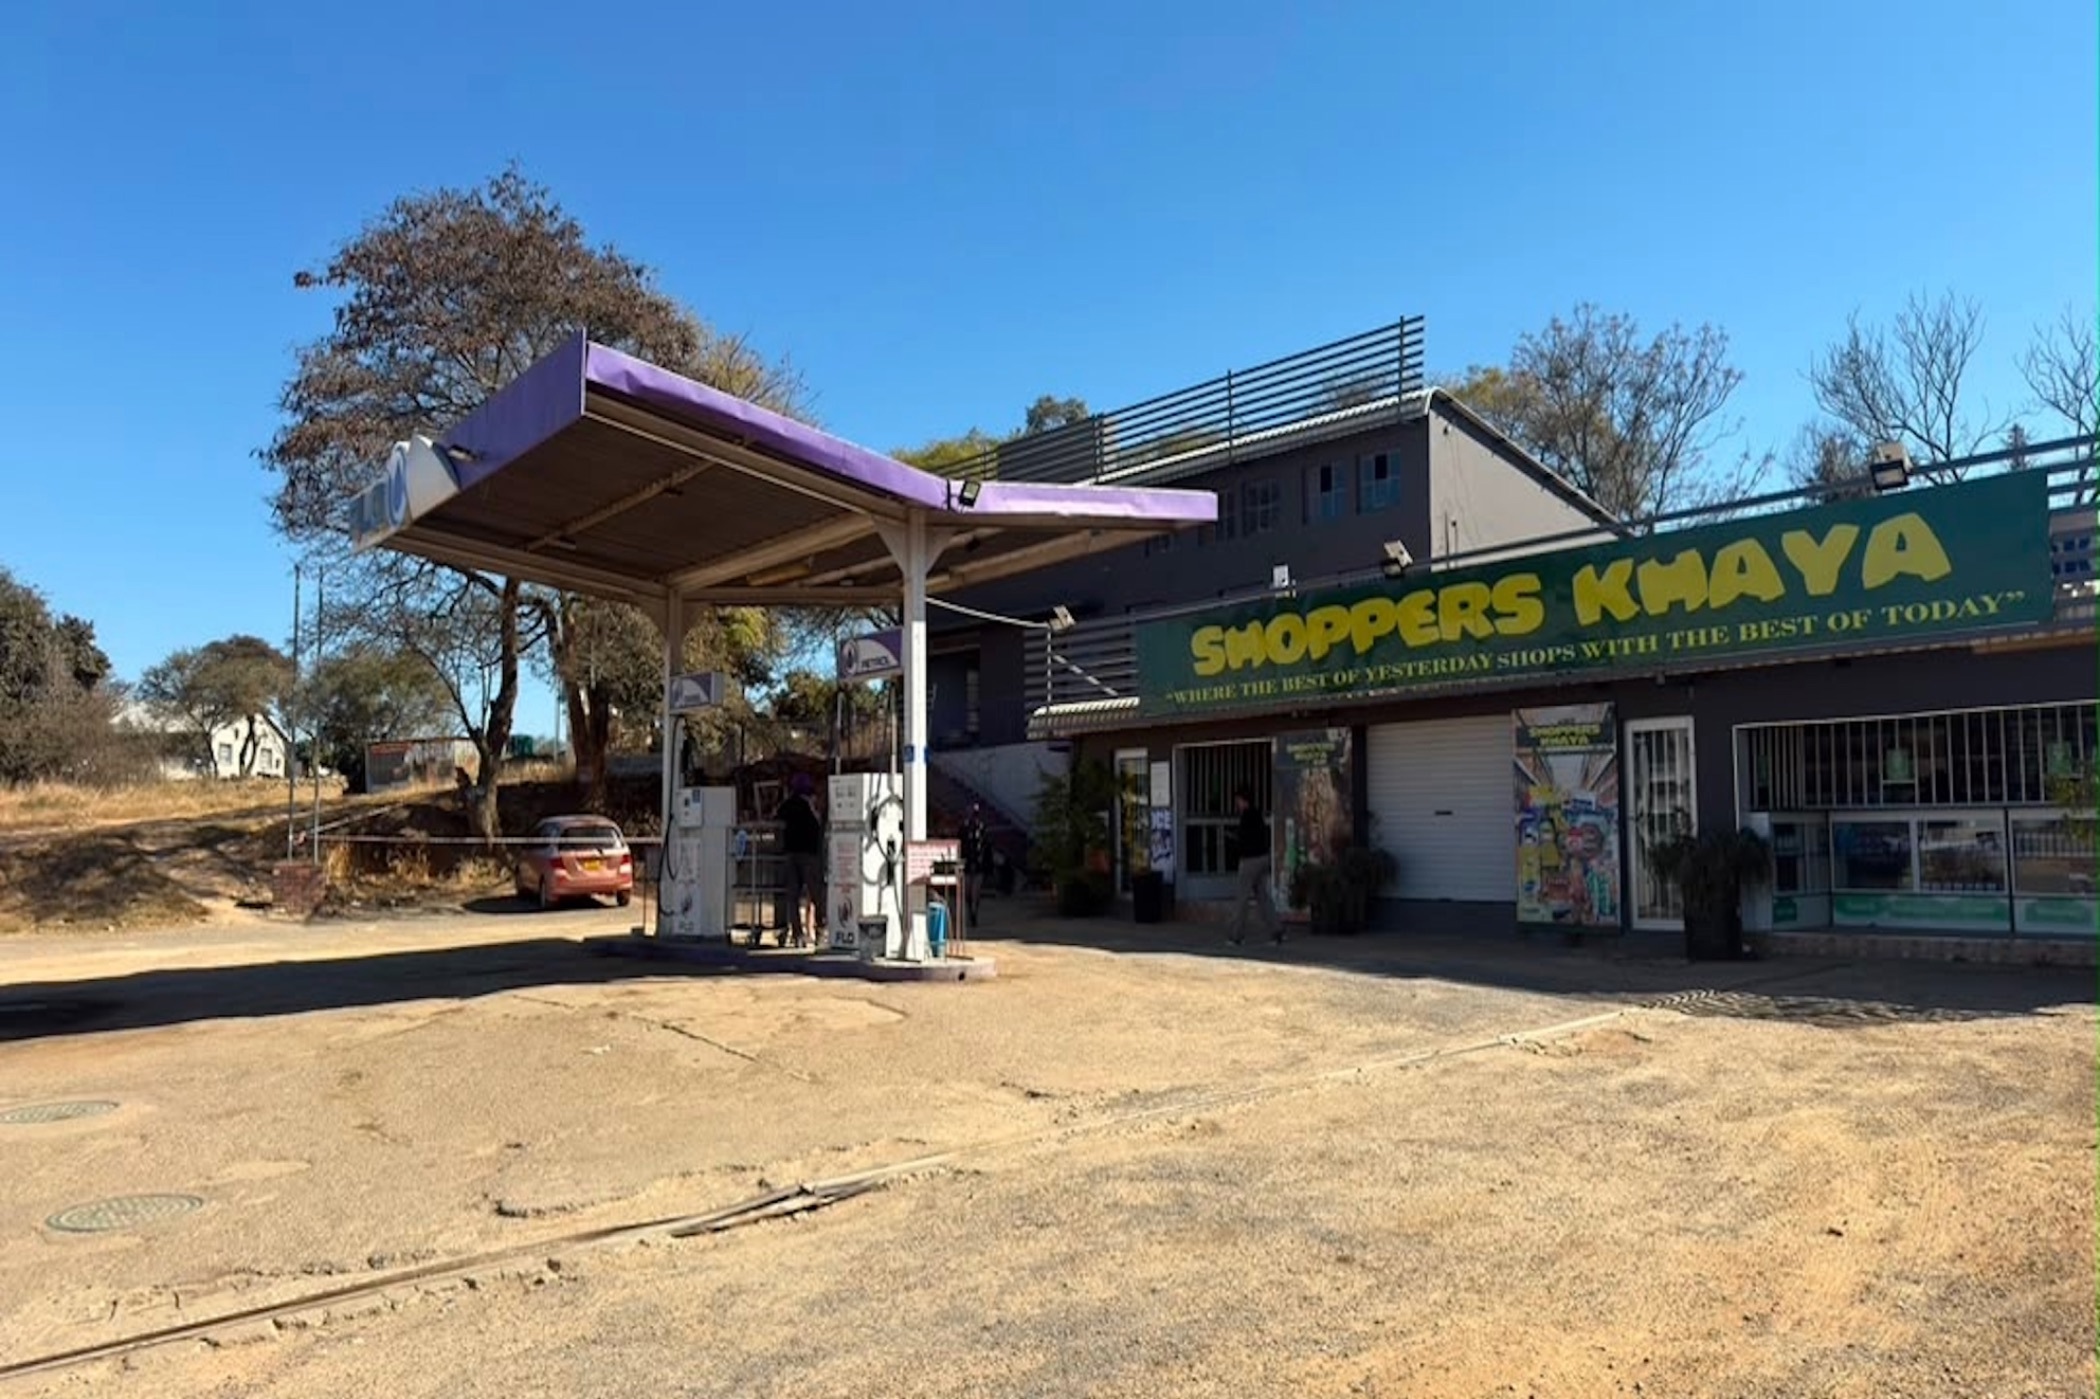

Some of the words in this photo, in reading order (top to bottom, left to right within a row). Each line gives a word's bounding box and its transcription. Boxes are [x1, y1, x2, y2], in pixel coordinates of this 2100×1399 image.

[1191, 573, 1545, 676] SHOPPERS
[1572, 512, 1952, 627] KHAYA
[1242, 680, 1278, 697] THE
[1282, 673, 1326, 692] BEST
[1333, 670, 1360, 686] OF
[1365, 653, 1492, 684] YESTERDAY
[1497, 644, 1576, 669] SHOPS
[1582, 634, 1658, 660] WITH
[1665, 625, 1730, 650] THE
[1738, 615, 1818, 642] BEST
[1826, 608, 1872, 632] OF
